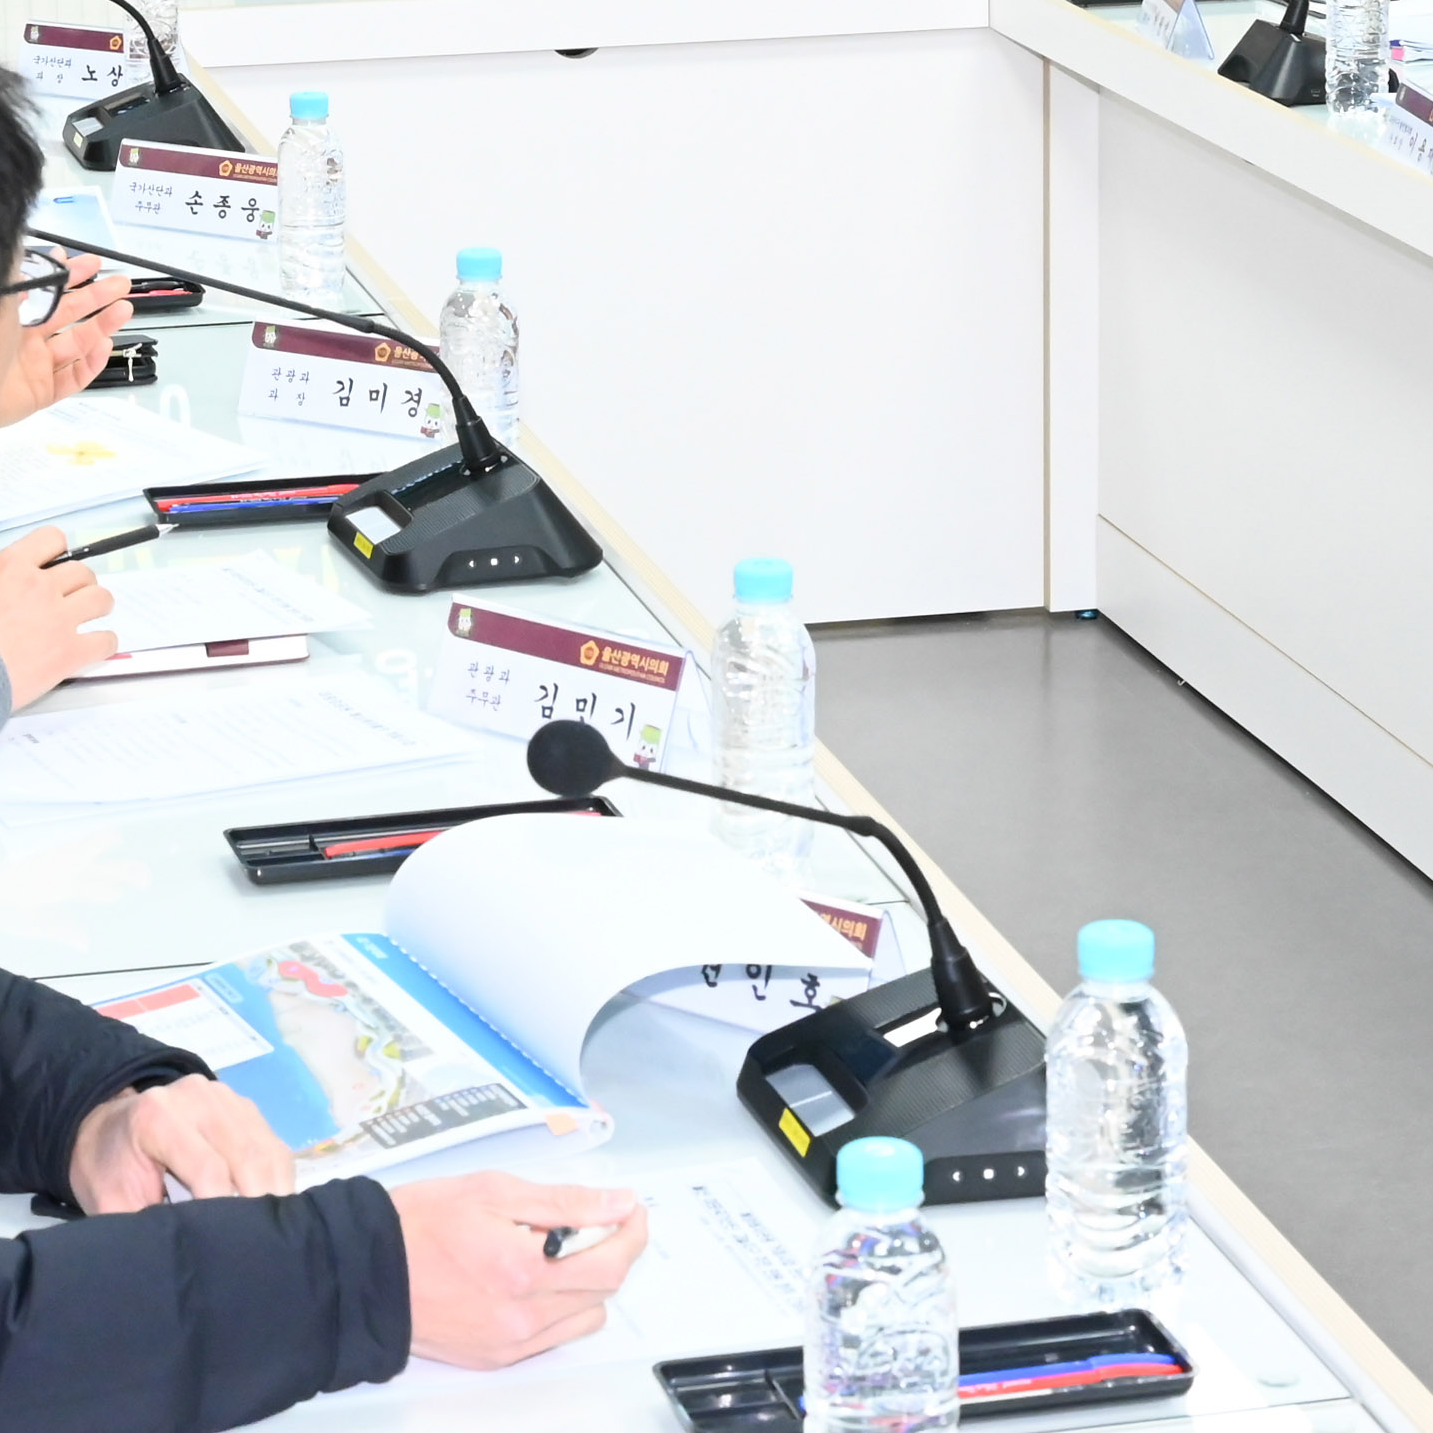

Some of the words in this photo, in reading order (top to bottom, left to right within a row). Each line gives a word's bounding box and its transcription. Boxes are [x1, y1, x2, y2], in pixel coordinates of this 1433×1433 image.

[234, 162, 278, 178] 울산광역시의
[129, 181, 173, 198] 국가산단과
[332, 377, 423, 418] 김미경
[601, 646, 669, 677] 울산광역시의회
